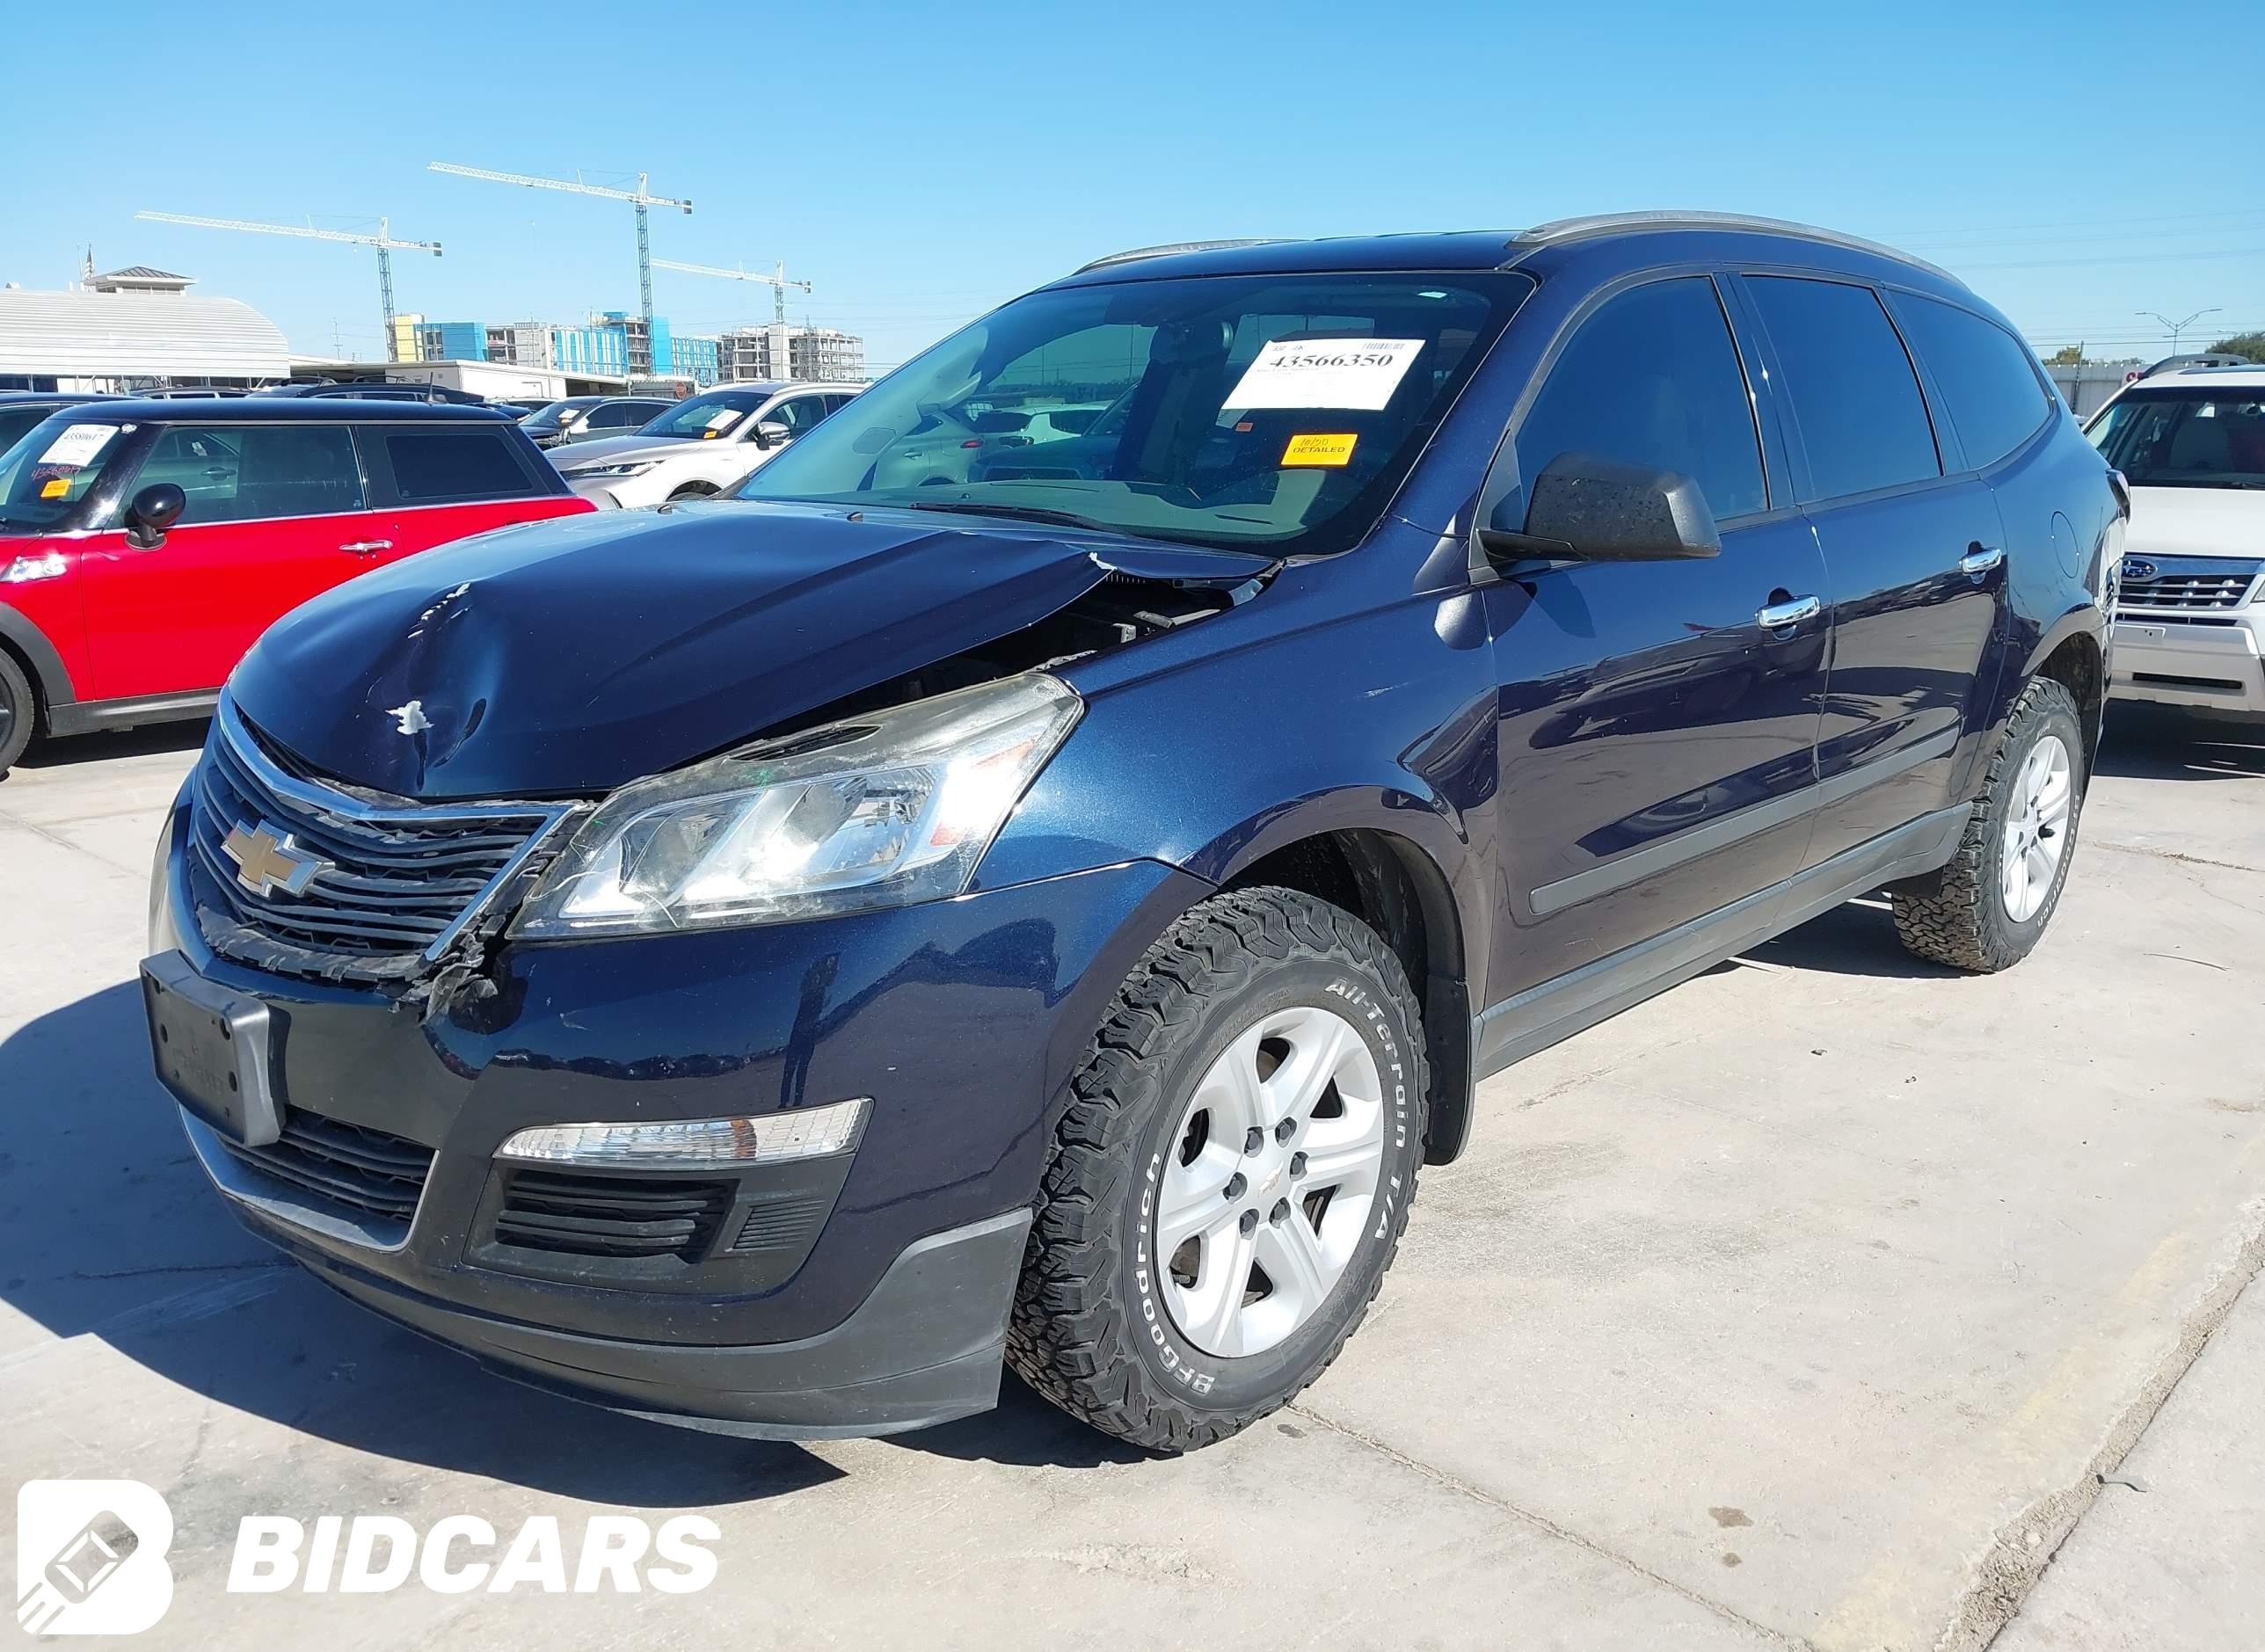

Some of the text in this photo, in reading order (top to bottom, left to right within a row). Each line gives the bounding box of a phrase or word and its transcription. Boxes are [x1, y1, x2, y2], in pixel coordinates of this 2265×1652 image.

[1270, 353, 1394, 368] 43566350
[1373, 1174, 1403, 1240] T/A
[1134, 1153, 1215, 1395] BFGoodrich
